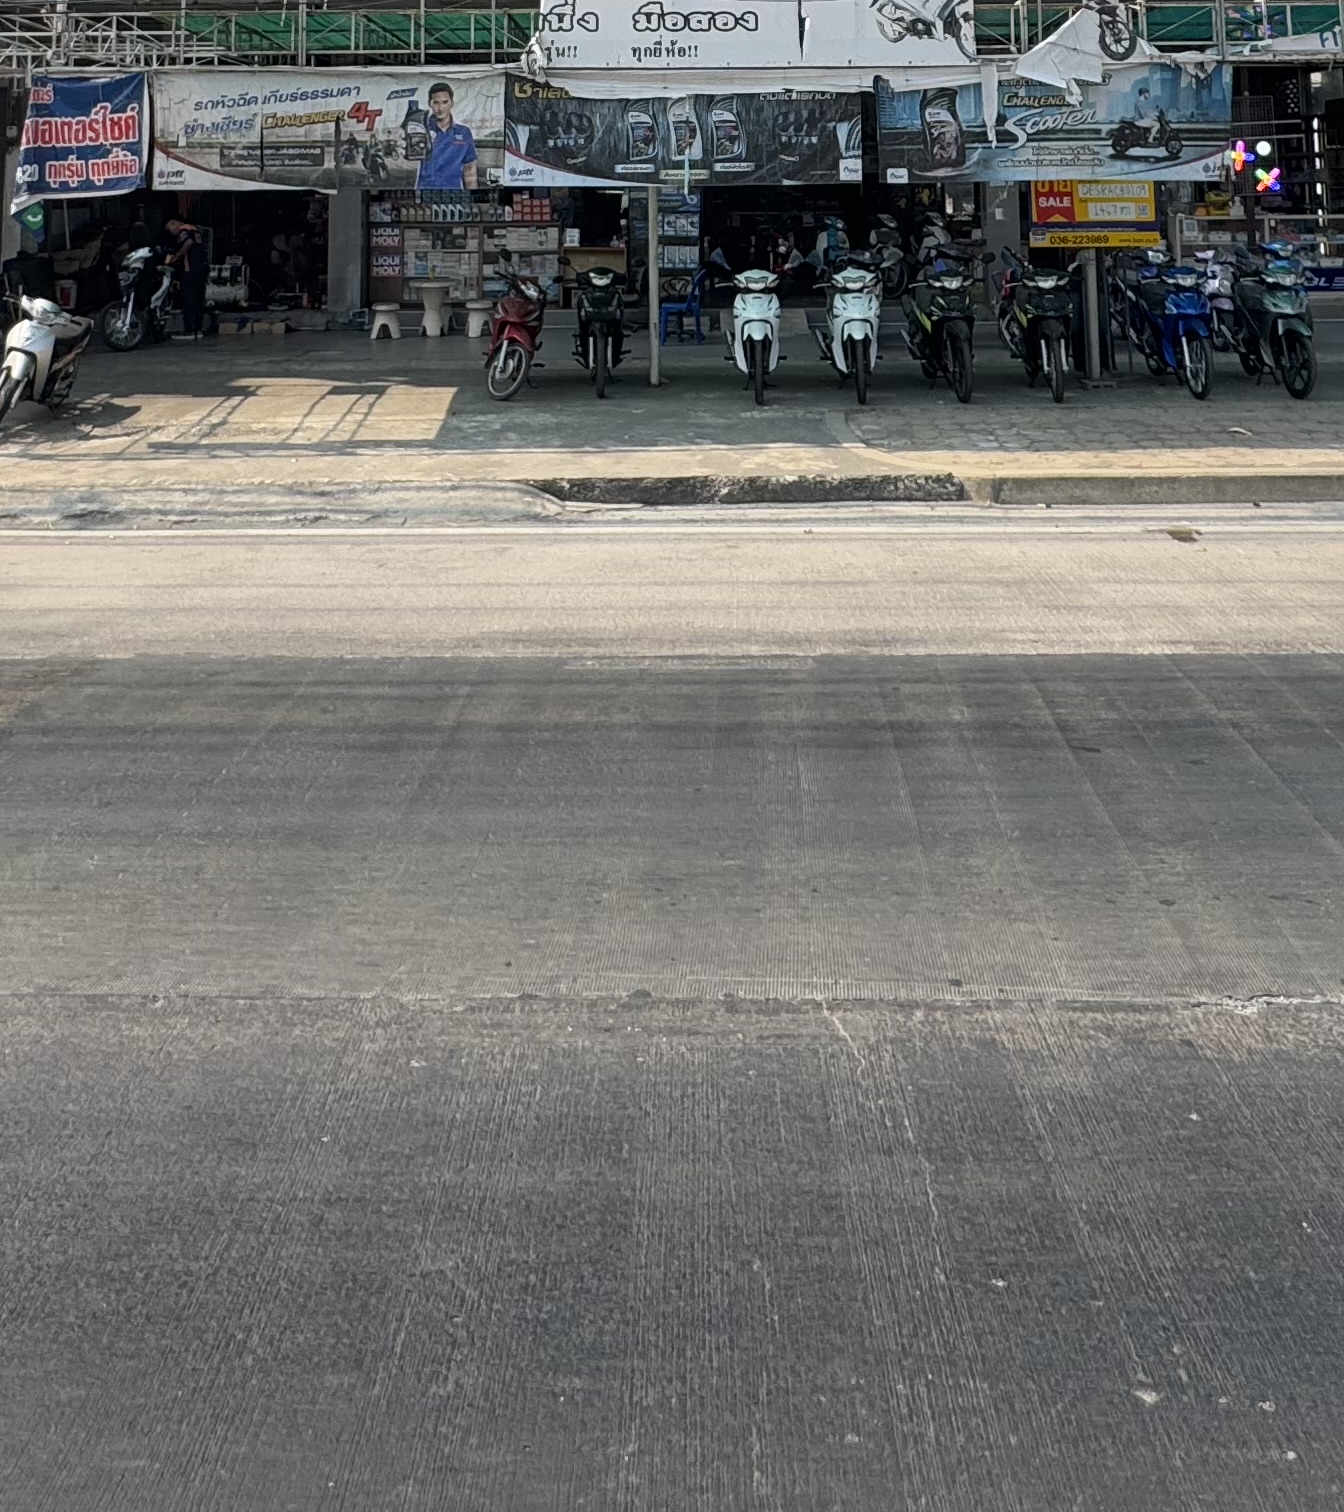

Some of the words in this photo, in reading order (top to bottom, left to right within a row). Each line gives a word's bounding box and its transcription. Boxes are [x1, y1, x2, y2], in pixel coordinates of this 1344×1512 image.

[632, 2, 759, 32] มือสอง
[347, 100, 382, 131] 4T
[1039, 196, 1071, 207] SALE
[372, 236, 401, 247] MOLY
[373, 266, 402, 277] MOLY
